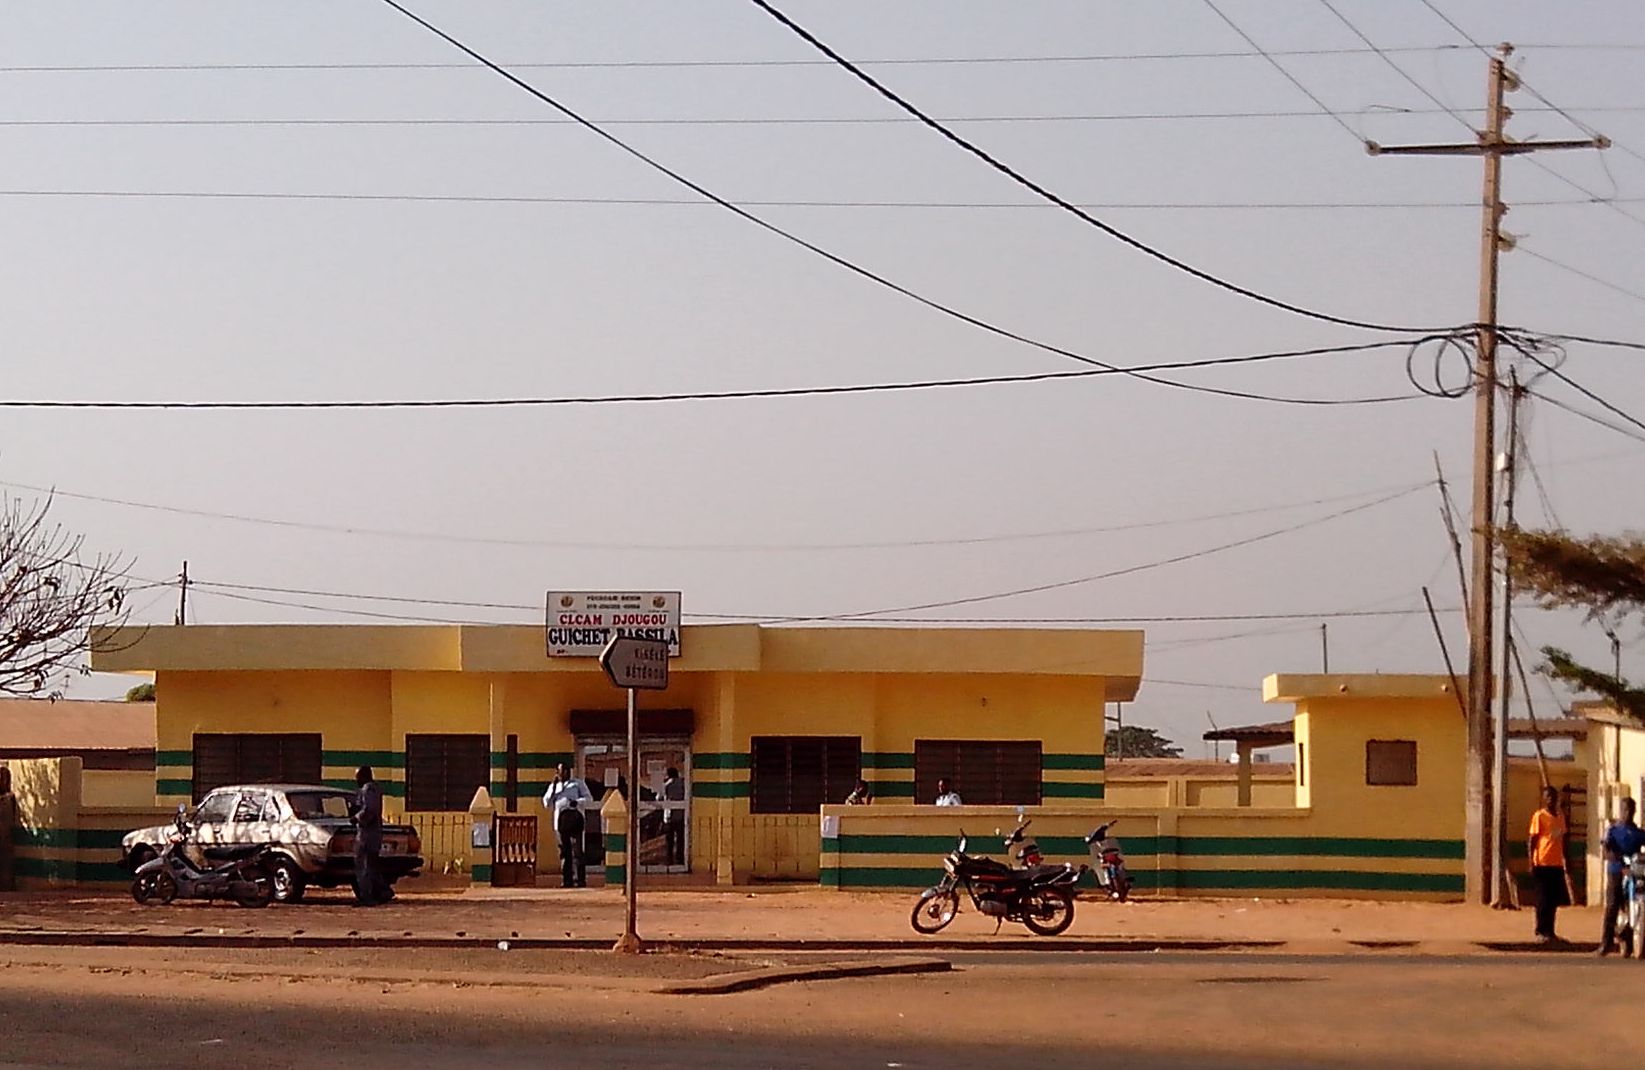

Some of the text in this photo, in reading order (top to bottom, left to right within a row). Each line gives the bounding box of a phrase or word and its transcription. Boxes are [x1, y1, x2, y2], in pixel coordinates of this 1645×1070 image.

[560, 614, 667, 625] CLCAM DJOUGOU
[549, 628, 610, 645] GUICHET
